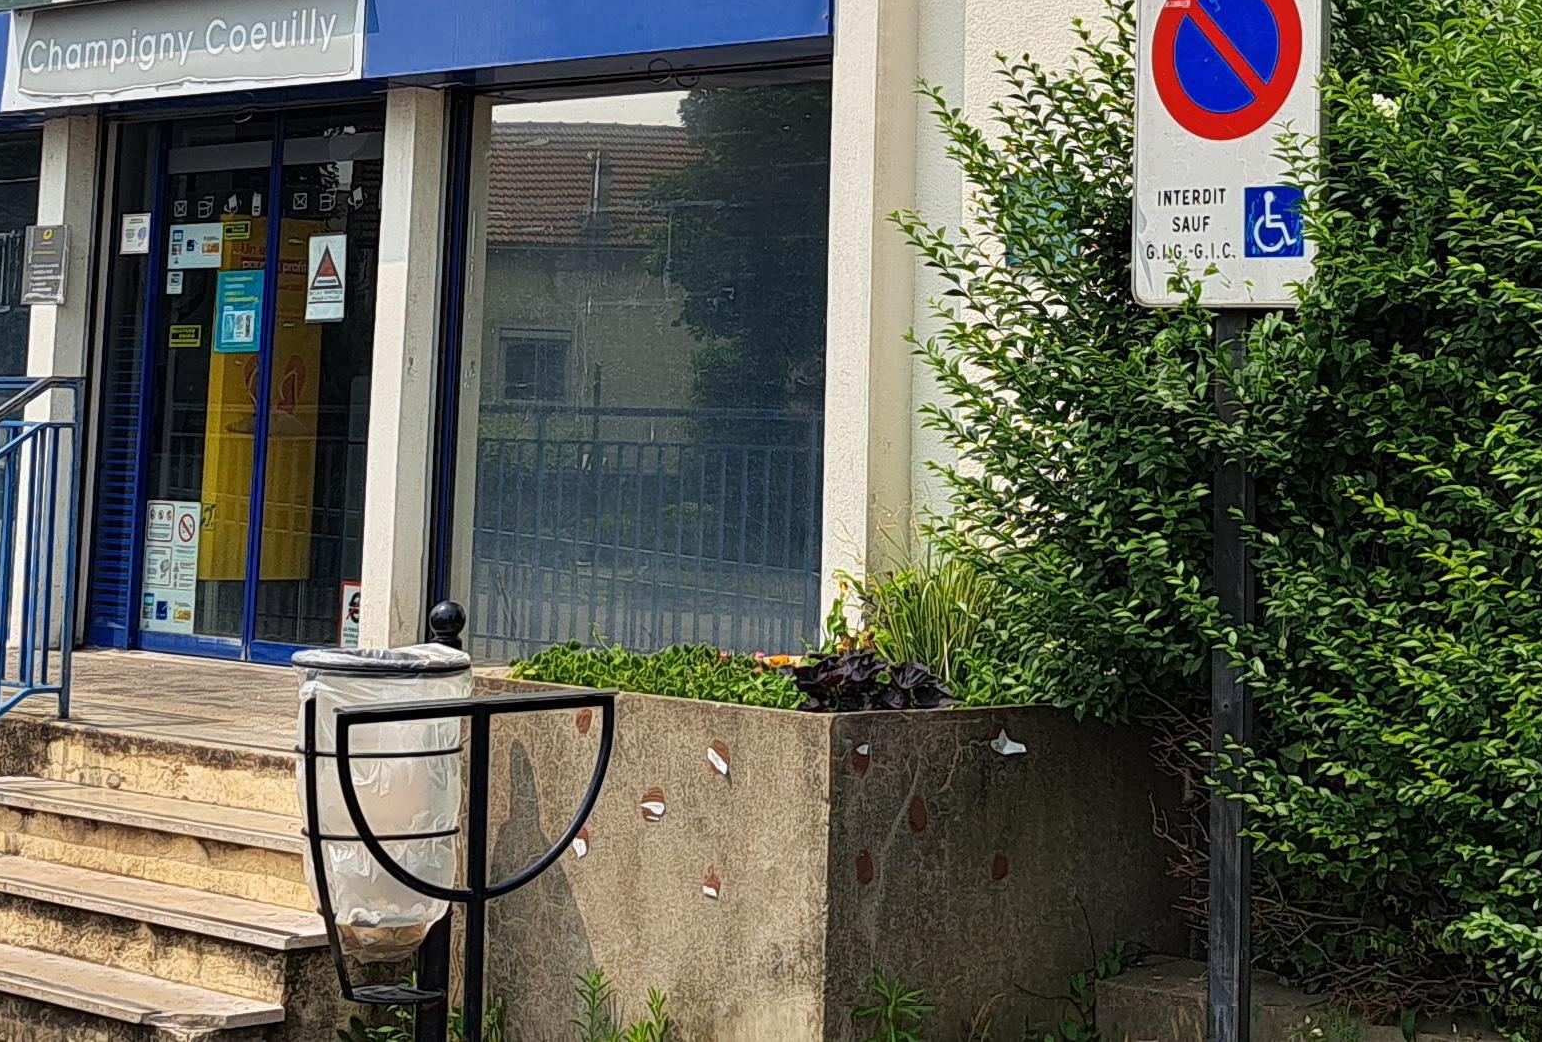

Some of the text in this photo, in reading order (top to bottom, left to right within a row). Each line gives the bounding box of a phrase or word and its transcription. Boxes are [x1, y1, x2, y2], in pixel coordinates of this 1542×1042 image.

[26, 8, 337, 74] Champigny Coeuilly
[1158, 188, 1226, 207] INTERDIT
[1172, 216, 1210, 233] SAUF
